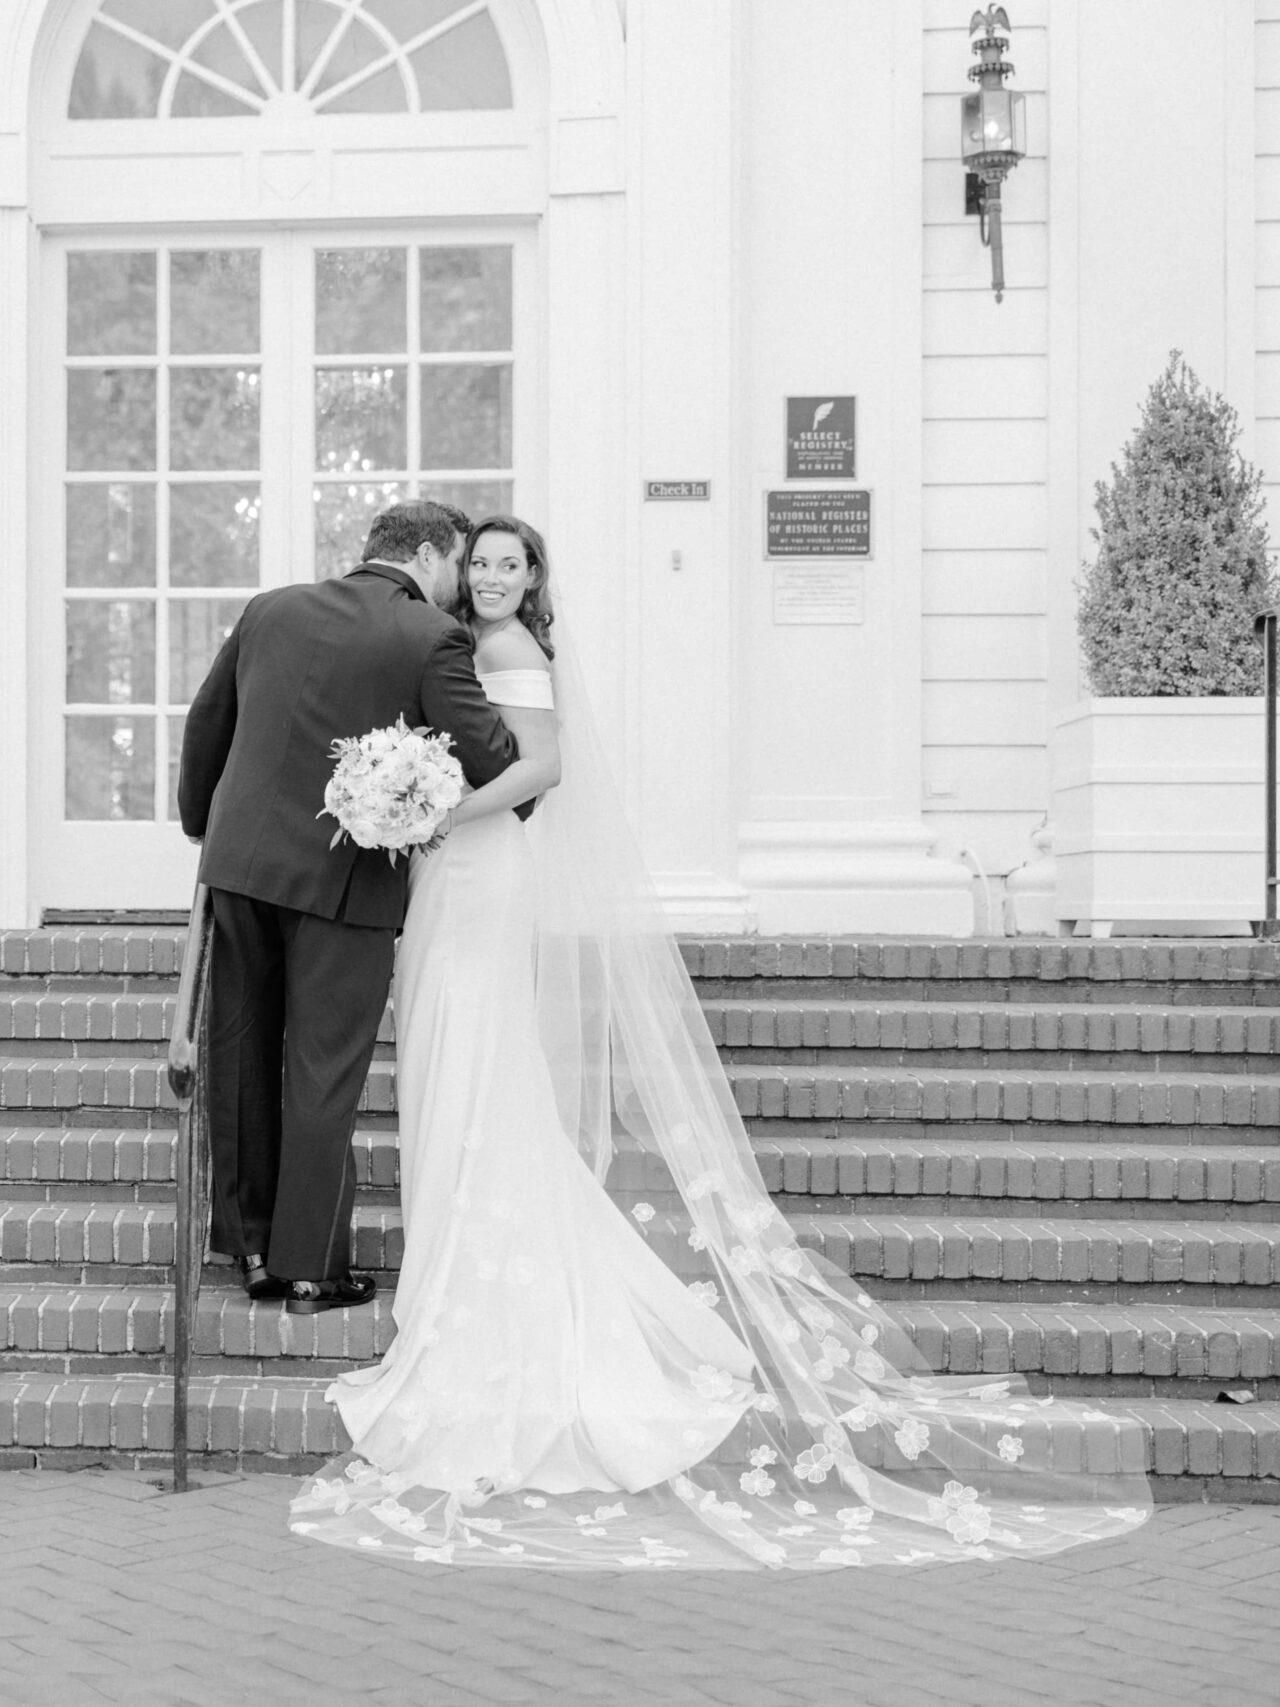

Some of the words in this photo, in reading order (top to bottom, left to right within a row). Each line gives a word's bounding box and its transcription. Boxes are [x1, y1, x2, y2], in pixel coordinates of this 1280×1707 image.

[800, 431, 841, 441] SELECT
[650, 483, 689, 496] Check
[691, 483, 704, 496] In
[769, 511, 816, 521] NATIONAL
[822, 511, 868, 521] REGISTER
[769, 524, 781, 534] OF
[785, 524, 828, 534] HISTORIC
[832, 524, 868, 534] PLACES
